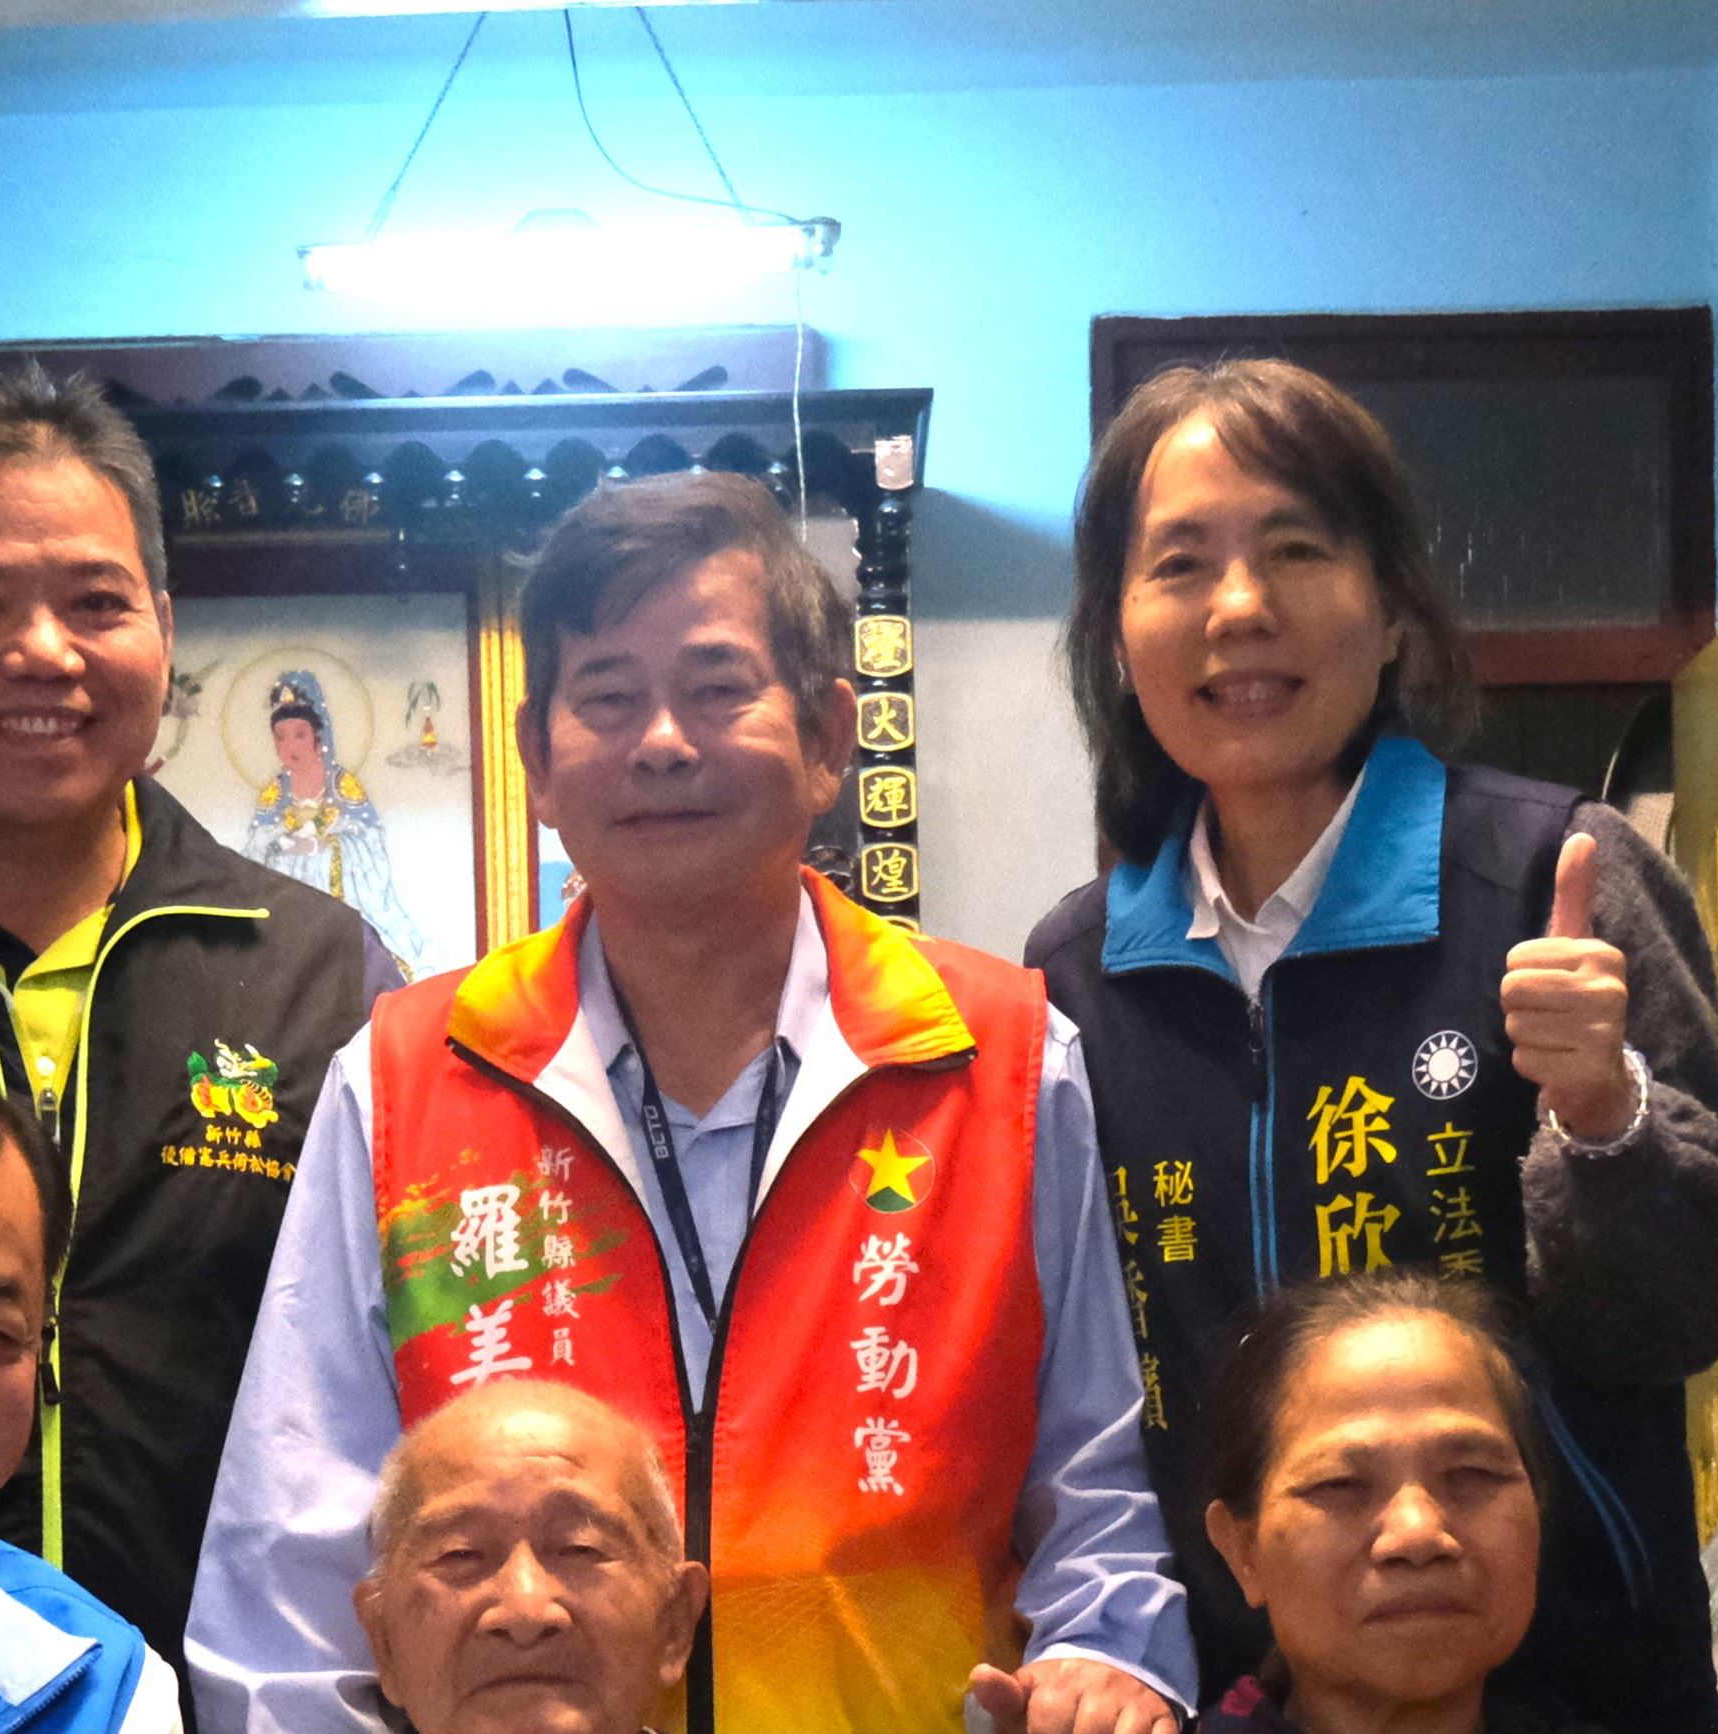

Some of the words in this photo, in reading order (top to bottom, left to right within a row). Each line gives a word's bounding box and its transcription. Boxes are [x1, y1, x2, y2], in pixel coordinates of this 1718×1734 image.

[205, 1123, 262, 1149] 新竹縣
[1152, 1159, 1199, 1263] 秘書
[538, 1144, 580, 1367] 新竹縣議員
[848, 1231, 920, 1497] 勞動黨
